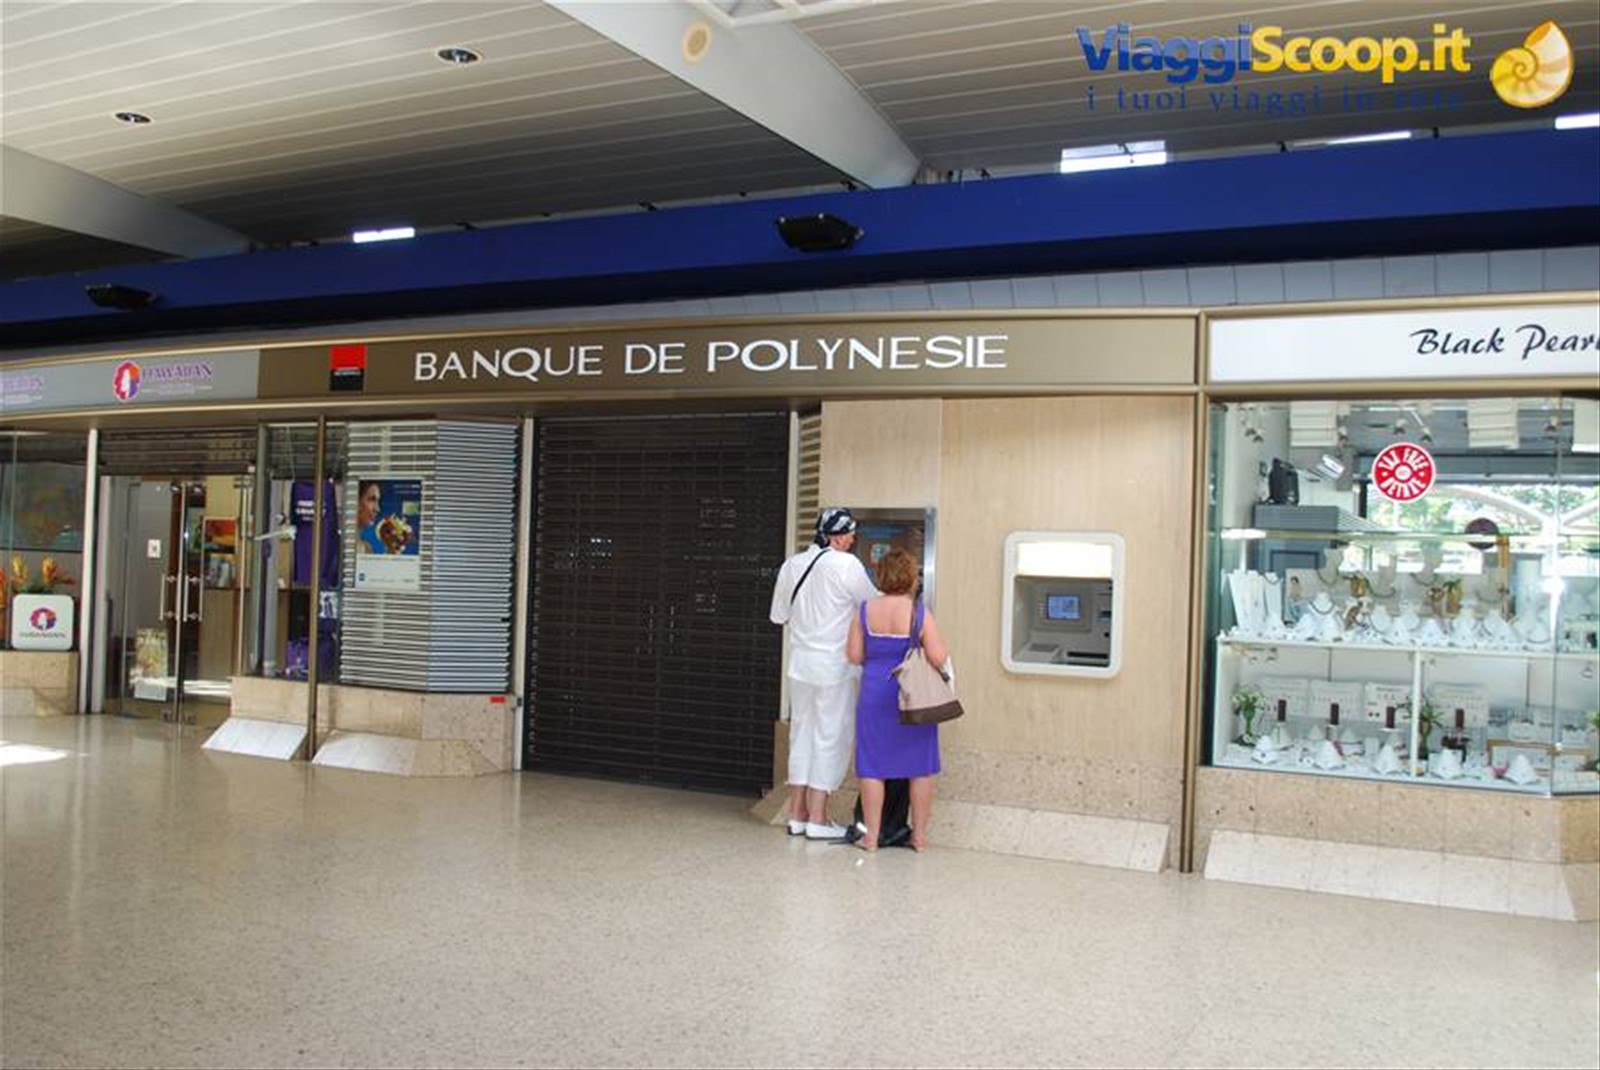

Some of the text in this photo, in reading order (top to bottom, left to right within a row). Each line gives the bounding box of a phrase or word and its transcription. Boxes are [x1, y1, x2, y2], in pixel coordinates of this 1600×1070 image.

[414, 335, 1009, 382] BANQUE DE POLYNESIE
[1409, 327, 1504, 355] Black
